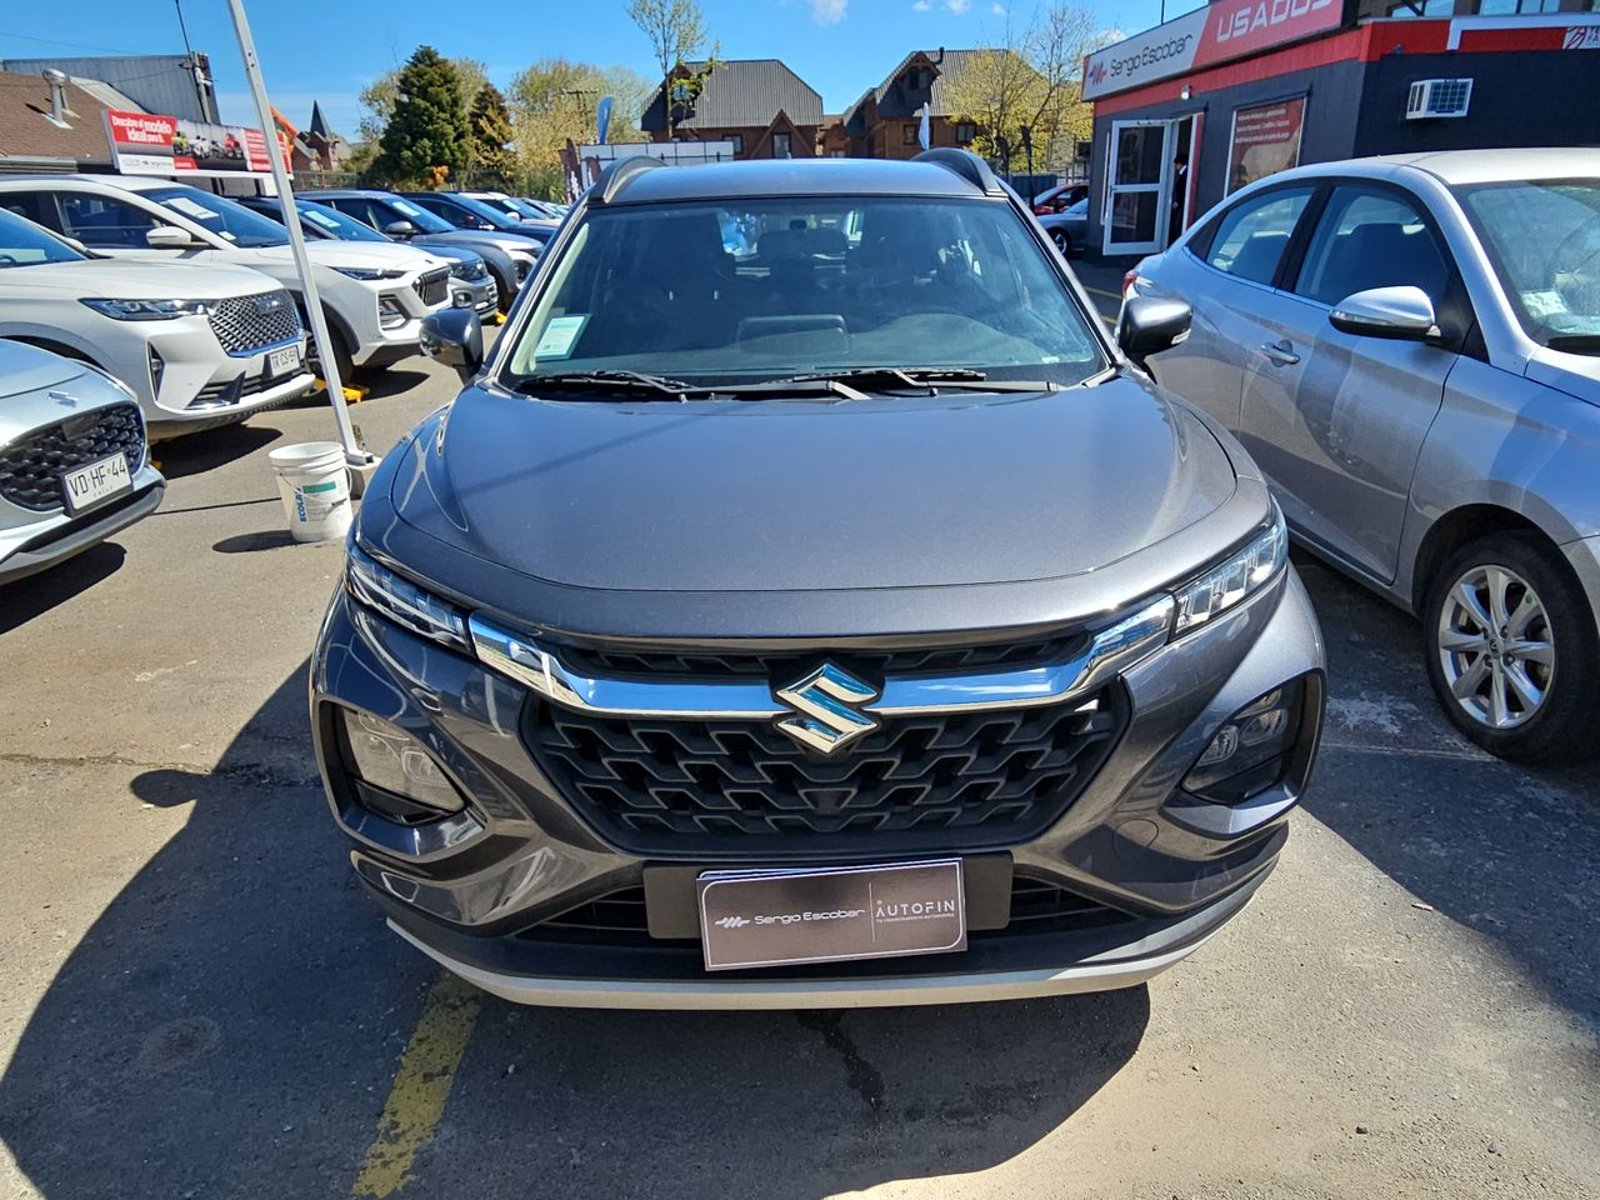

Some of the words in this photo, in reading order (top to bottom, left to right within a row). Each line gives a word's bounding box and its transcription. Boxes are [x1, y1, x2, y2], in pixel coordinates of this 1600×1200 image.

[1110, 58, 1141, 77] Sergo
[1142, 34, 1193, 66] Escobar
[754, 914, 801, 925] Sergo
[803, 909, 866, 921] Escobar
[876, 899, 955, 918] AUTOFIN
